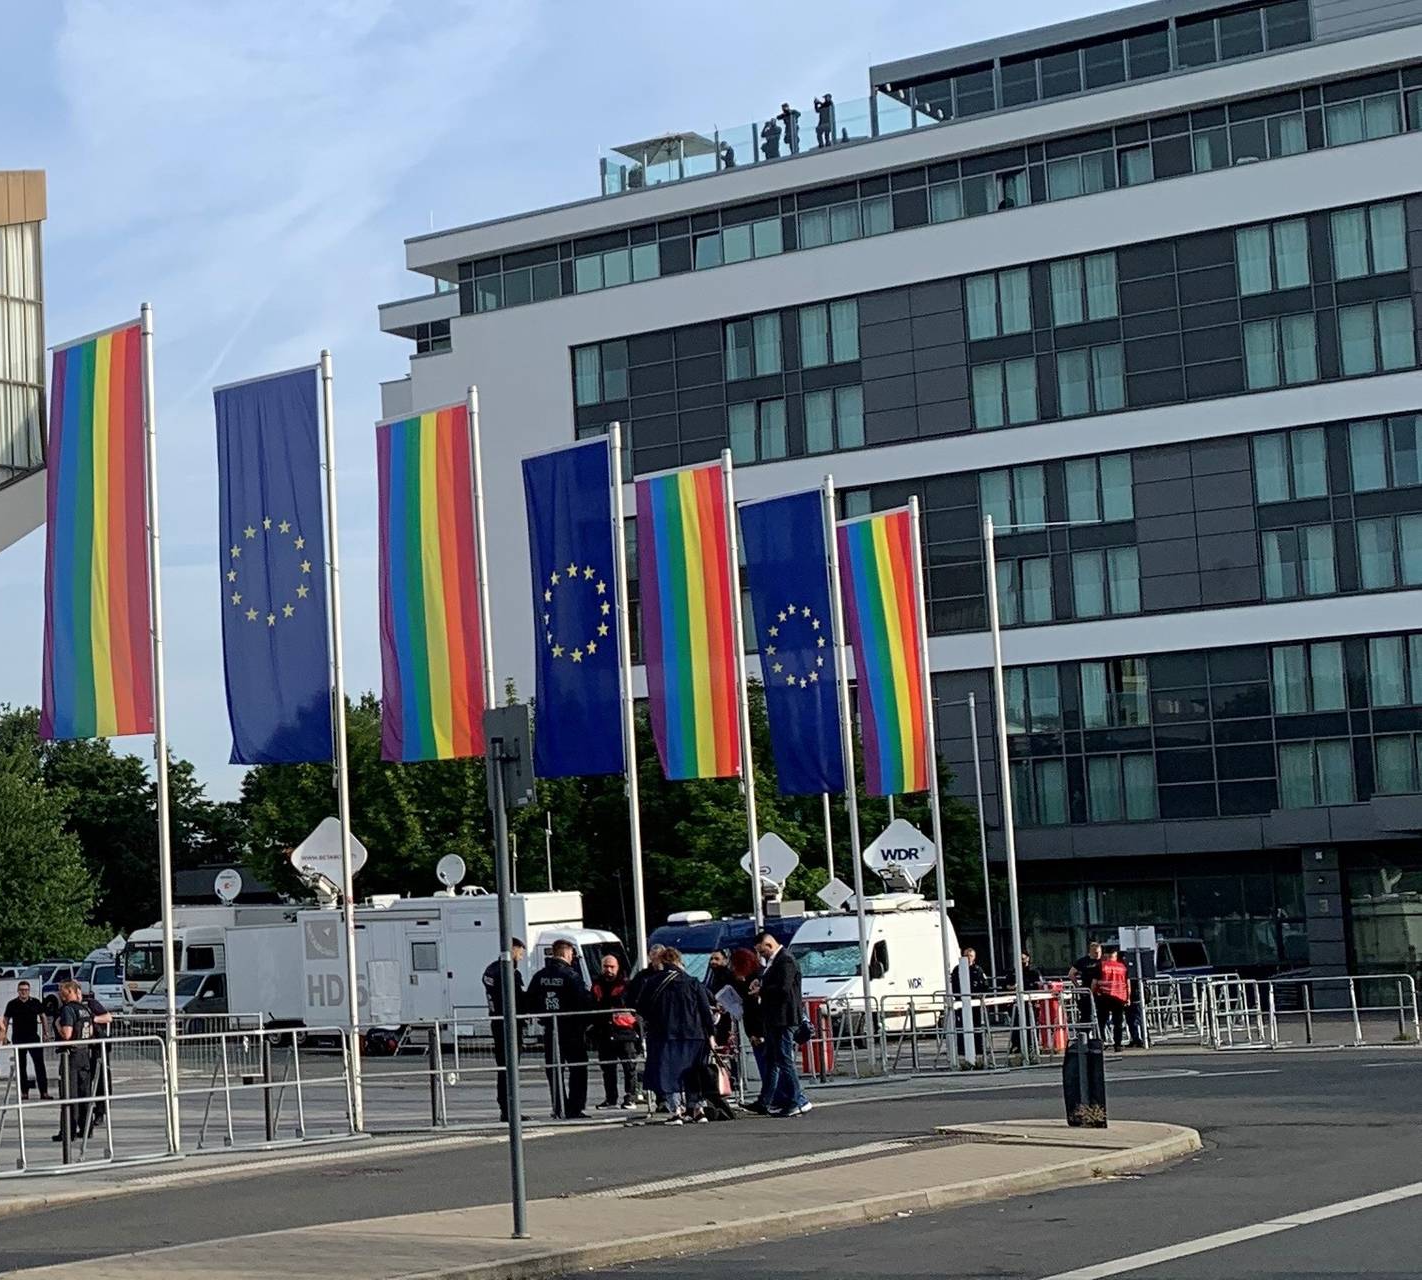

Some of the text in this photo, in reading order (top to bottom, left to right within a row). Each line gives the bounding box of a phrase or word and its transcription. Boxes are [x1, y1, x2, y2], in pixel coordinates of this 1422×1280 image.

[881, 848, 920, 861] WDR
[907, 977, 923, 989] WDR
[307, 974, 345, 1007] HD
